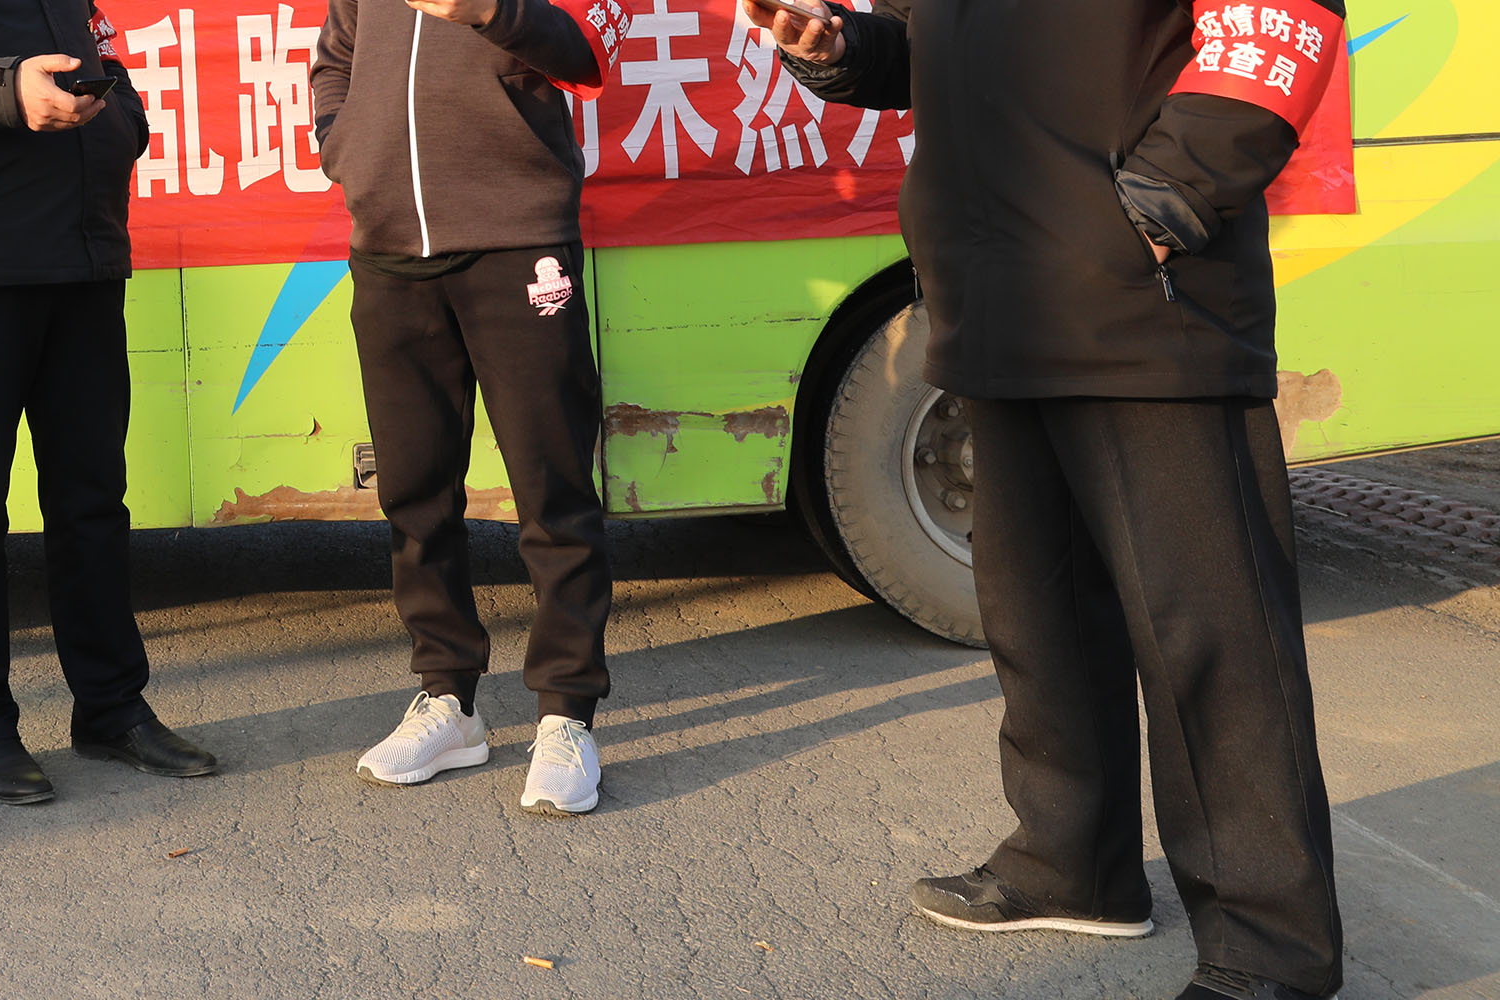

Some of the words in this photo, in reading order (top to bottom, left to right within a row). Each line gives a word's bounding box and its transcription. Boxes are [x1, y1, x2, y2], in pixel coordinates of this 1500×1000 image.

[1197, 3, 1324, 64] 疫情防控
[1196, 38, 1298, 97] 检查员
[125, 3, 333, 198] 乱跑
[529, 288, 573, 306] Reebok
